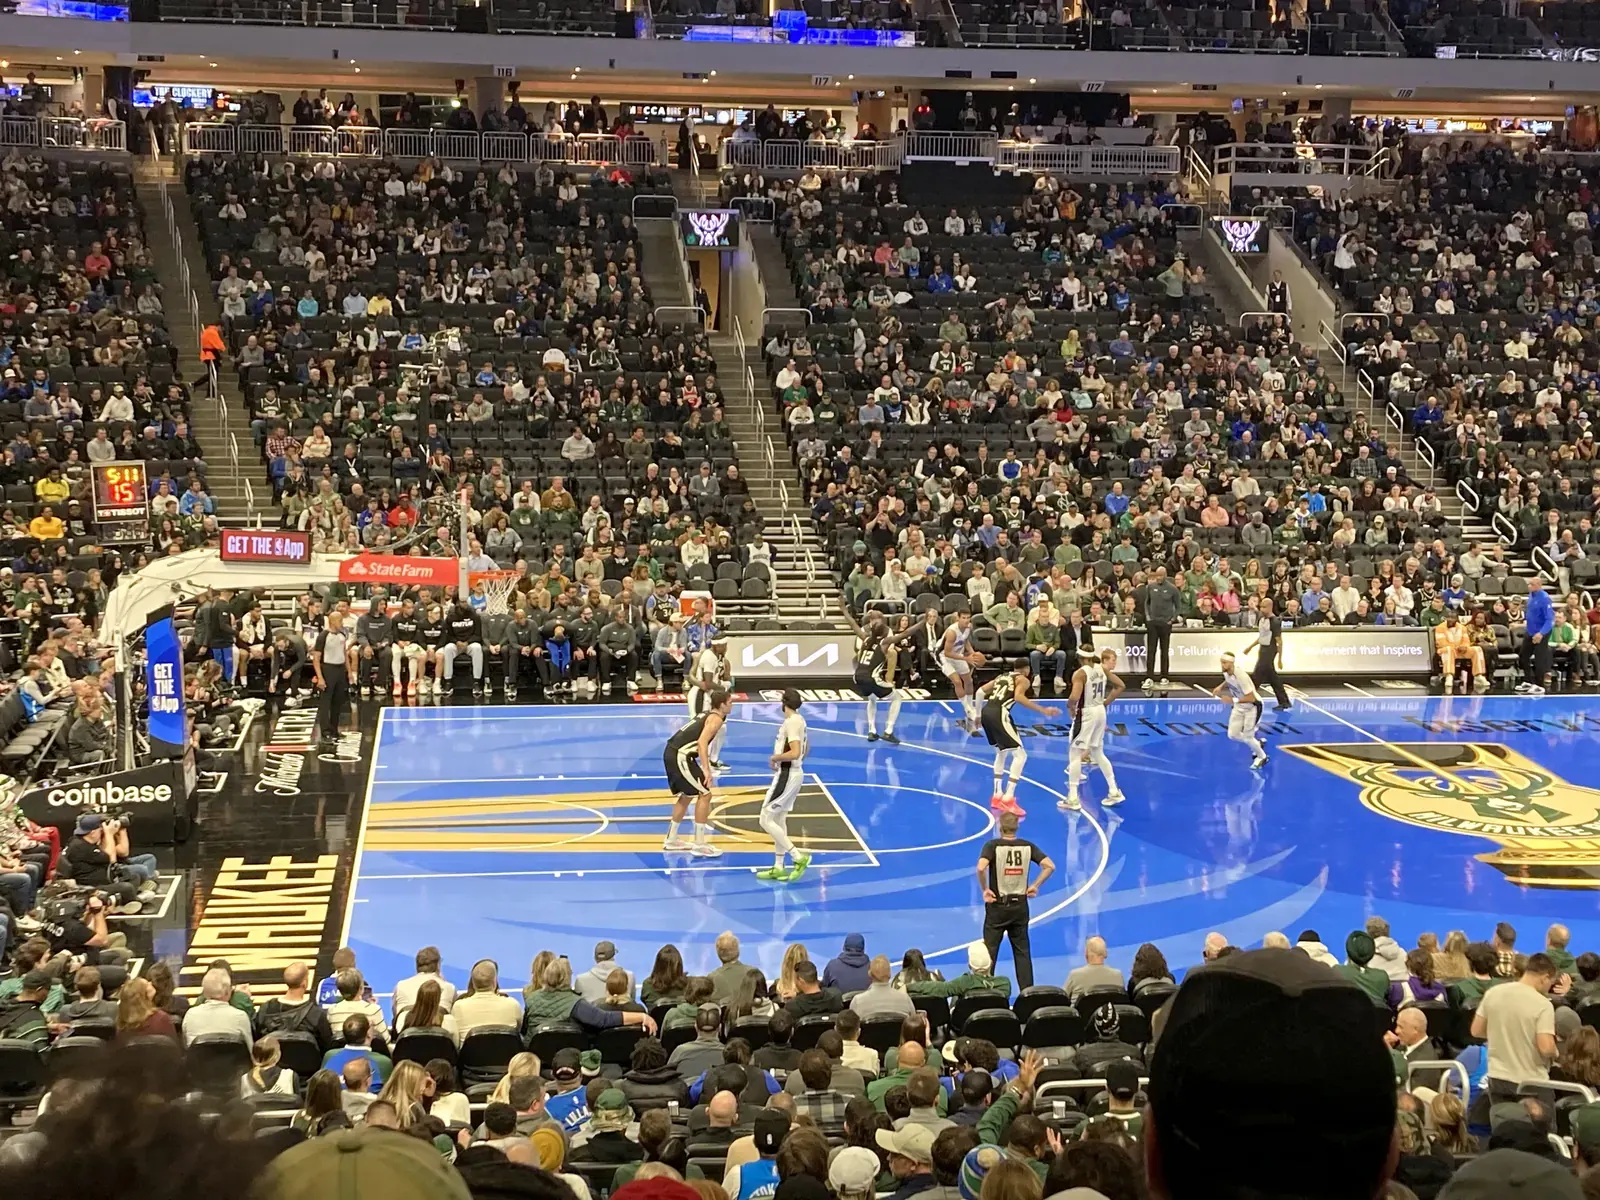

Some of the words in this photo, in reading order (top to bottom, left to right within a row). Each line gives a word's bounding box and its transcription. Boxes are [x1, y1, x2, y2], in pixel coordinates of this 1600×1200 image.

[814, 77, 829, 86] 117
[1086, 83, 1102, 92] 117
[114, 483, 135, 502] 15
[111, 507, 146, 517] TISSOT
[227, 535, 248, 555] GET
[251, 536, 272, 556] THE
[284, 538, 304, 559] App
[860, 650, 874, 665] 12
[1177, 645, 1222, 657] Tellurid
[1359, 645, 1381, 656] that
[1383, 645, 1423, 657] inspires
[153, 663, 174, 679] GET
[154, 679, 175, 695] THE
[796, 689, 863, 701] NBA
[1092, 681, 1104, 699] 34
[161, 696, 179, 713] App
[270, 707, 319, 744] ULTRA
[254, 752, 305, 796] Michelob
[47, 781, 172, 806] coinbase
[1407, 810, 1593, 838] MILWAUKEE
[1005, 850, 1022, 866] 48
